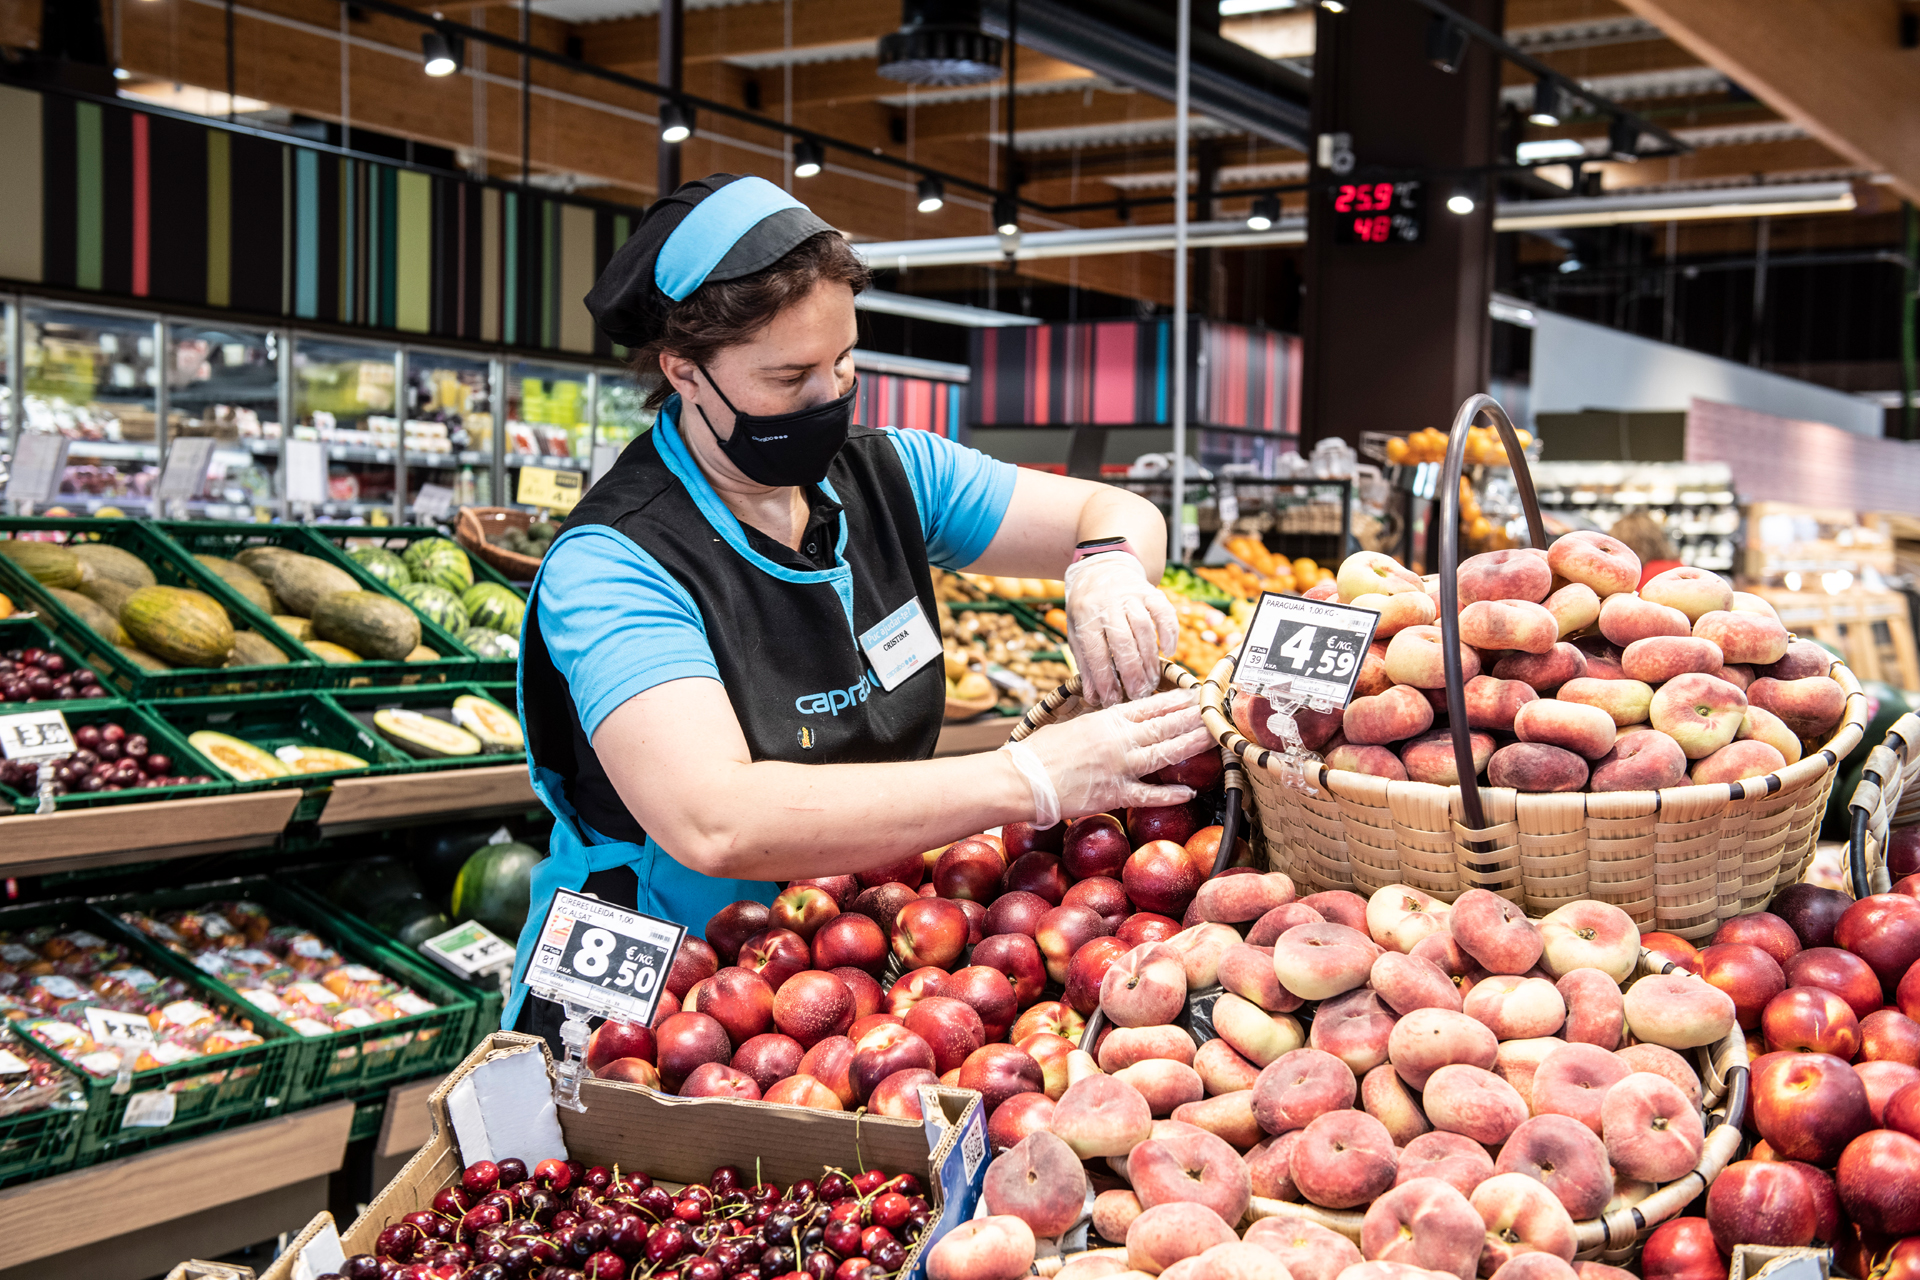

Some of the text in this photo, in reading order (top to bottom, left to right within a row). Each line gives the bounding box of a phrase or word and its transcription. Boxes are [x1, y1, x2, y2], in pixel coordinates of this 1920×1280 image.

[1353, 215, 1391, 242] 48
[1308, 606, 1324, 616] 1,00
[1324, 608, 1335, 617] KG
[866, 606, 912, 645] Puc ajudar-te?
[882, 629, 910, 652] CRISTINA
[1280, 625, 1356, 677] 4,59
[1249, 654, 1262, 665] 39
[556, 906, 592, 922] KG ALSAT
[560, 895, 634, 925] CIRERES LLEIDA 1,00
[542, 954, 554, 965] 81
[572, 927, 657, 994] 8,50
